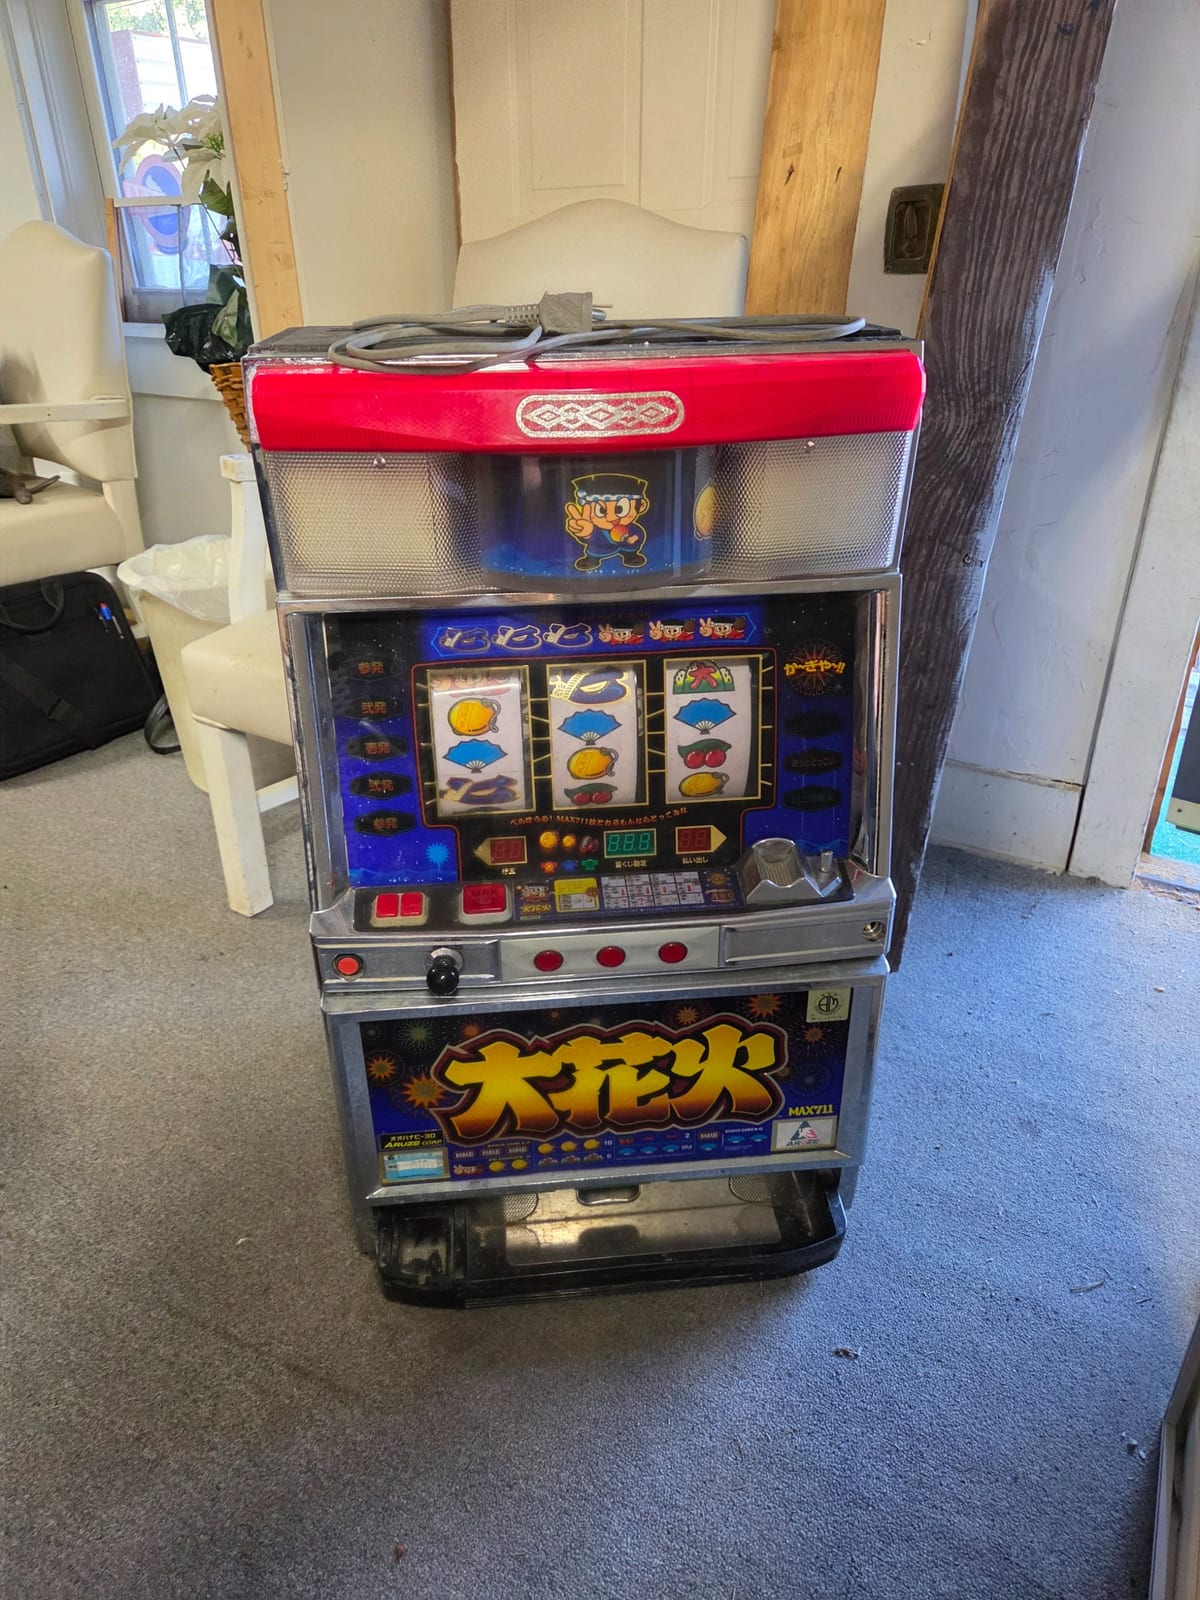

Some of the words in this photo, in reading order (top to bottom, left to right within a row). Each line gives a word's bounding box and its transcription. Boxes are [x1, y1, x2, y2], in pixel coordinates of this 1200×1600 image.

[445, 1024, 776, 1138] 大花火
[788, 1104, 833, 1117] MAX711
[383, 1140, 422, 1149] ARUZE
